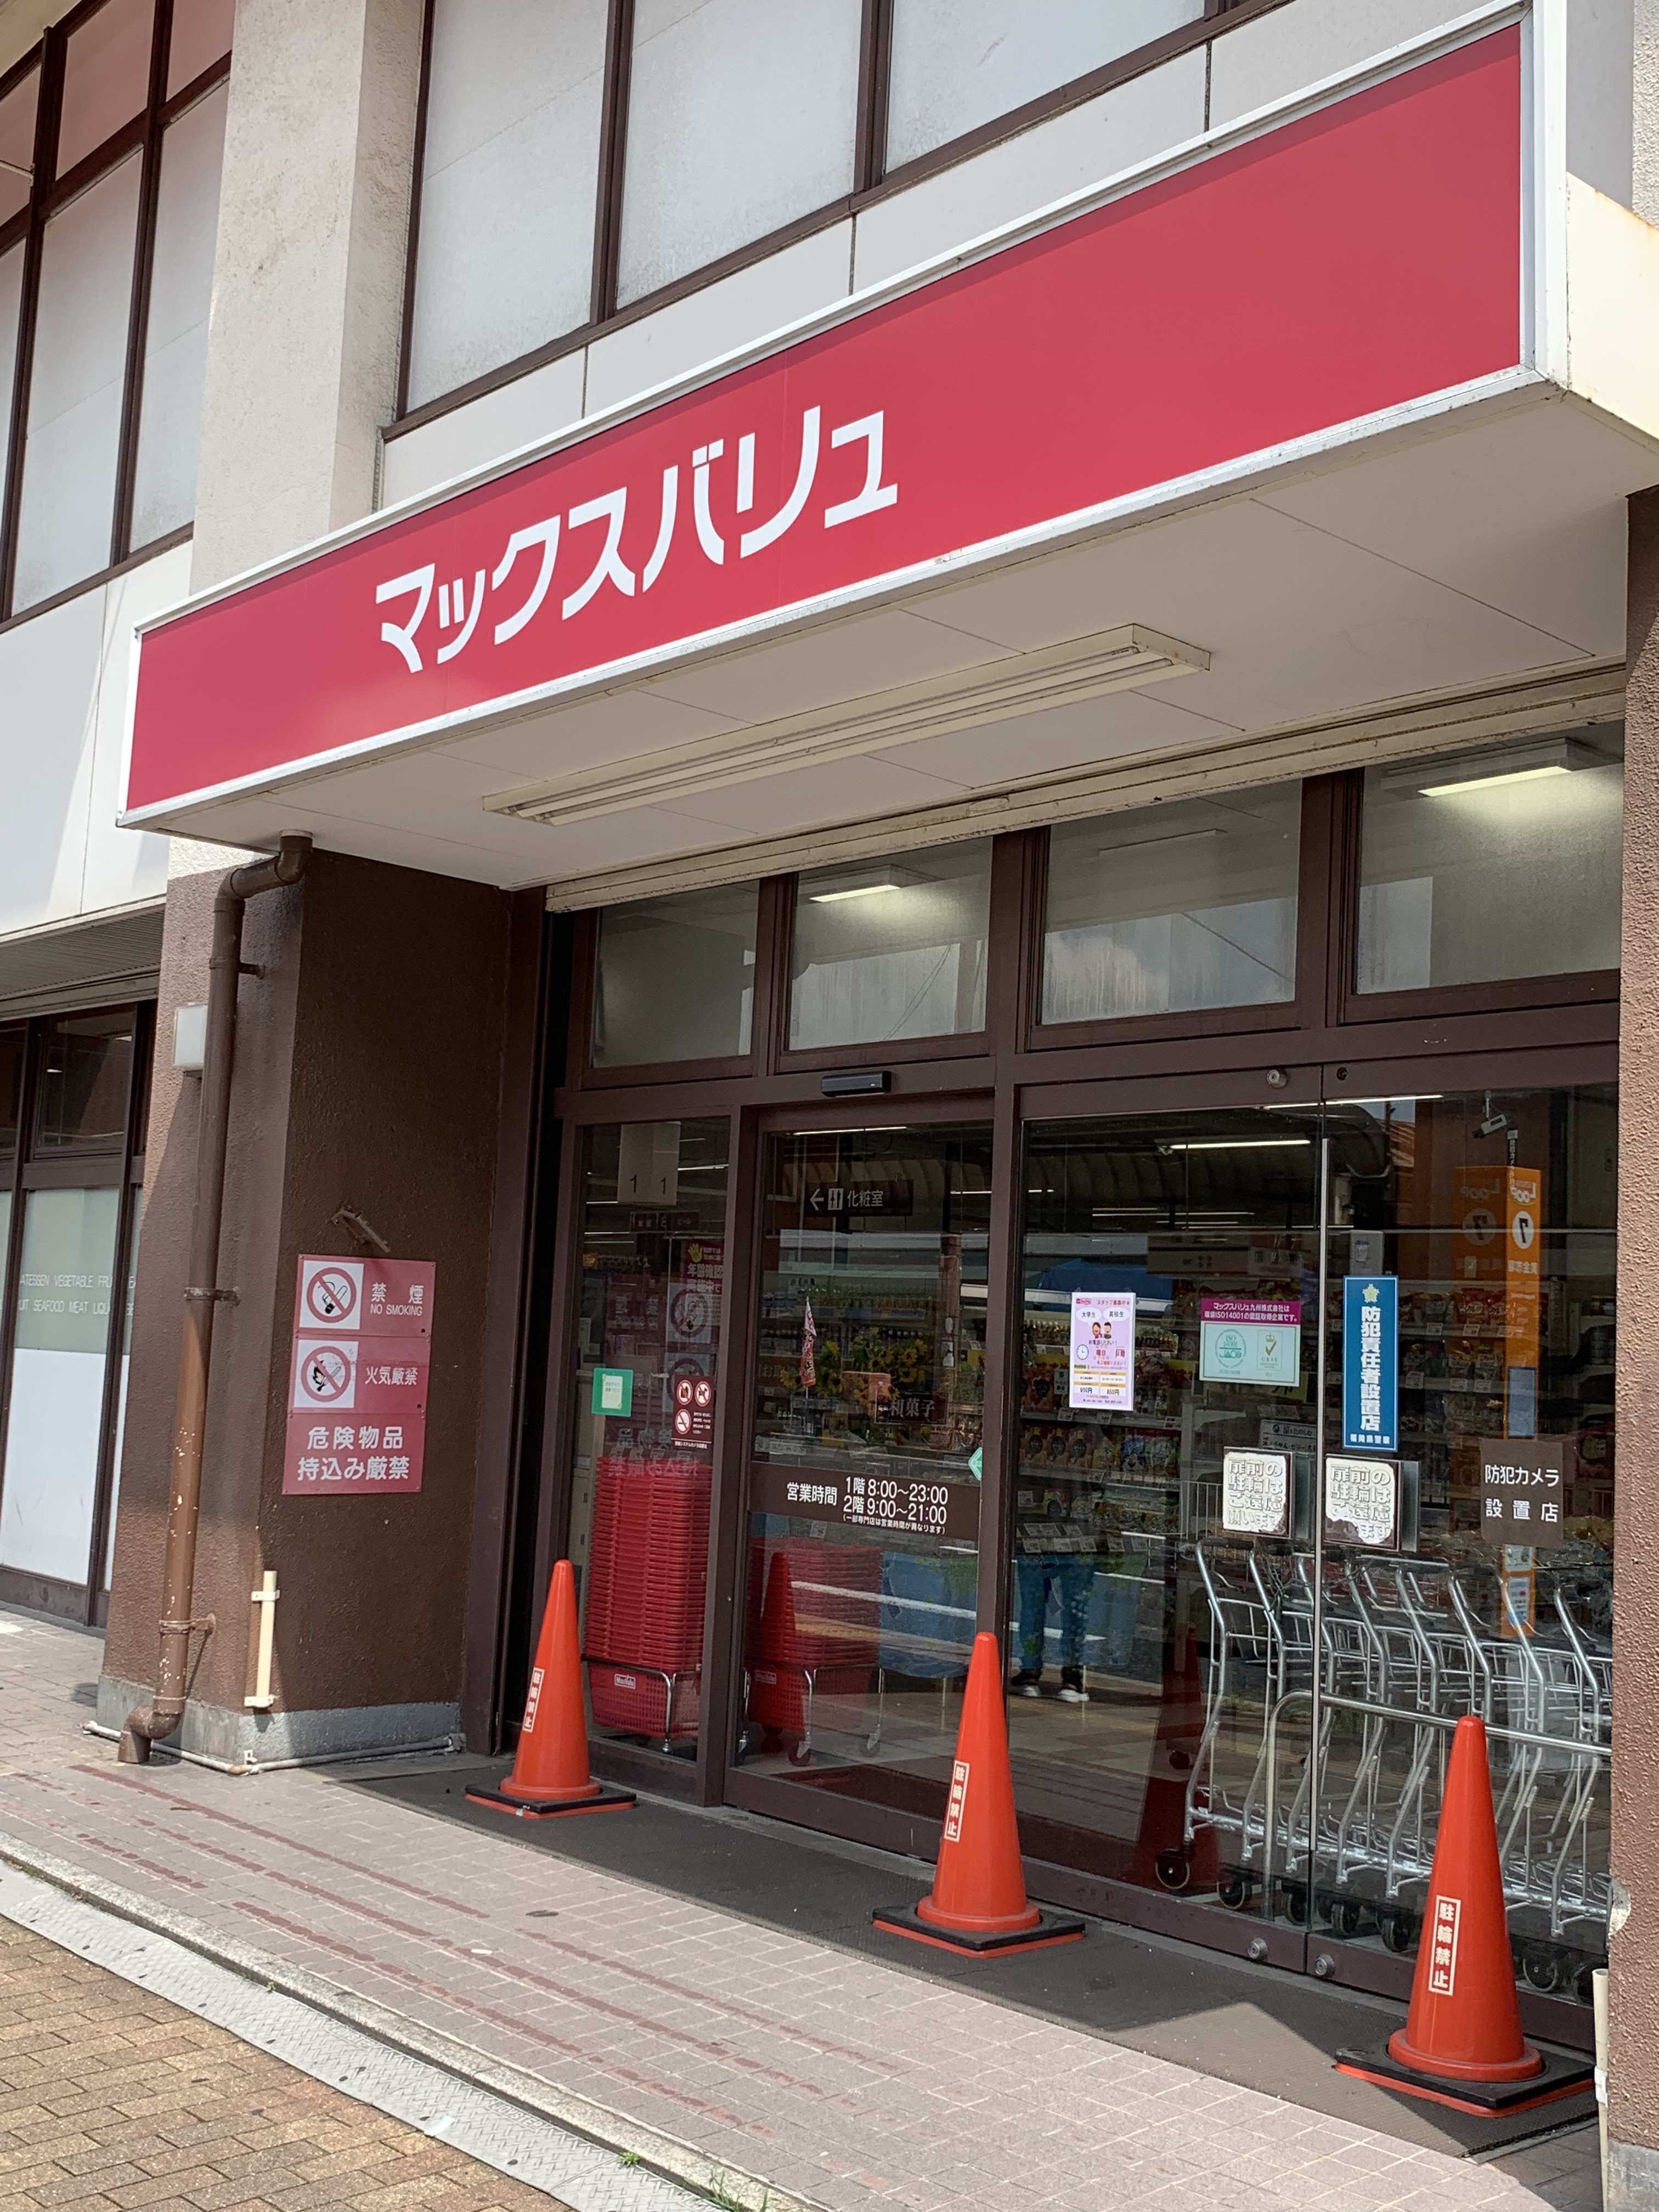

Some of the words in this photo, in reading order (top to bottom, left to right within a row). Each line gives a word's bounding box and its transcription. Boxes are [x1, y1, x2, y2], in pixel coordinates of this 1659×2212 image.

[375, 404, 898, 674] マックスバリュ
[847, 1189, 884, 1208] 化粧室
[54, 1275, 93, 1288] VEGETABLE
[98, 1276, 113, 1288] FRU
[33, 1299, 65, 1313] SEAFOOD
[69, 1301, 89, 1314] MEAT
[93, 1302, 110, 1316] LIQU
[370, 1304, 383, 1316] NO
[386, 1304, 423, 1317] SMOKING
[1213, 1302, 1290, 1313] マックスバリュ九州株式会社は
[365, 1366, 417, 1386] 火気厳禁
[1360, 1305, 1381, 1432] 防犯責任者設置店
[890, 1397, 936, 1419] 和菓子
[307, 1425, 403, 1451] 危険物品
[297, 1456, 410, 1481] 持込み厳禁
[1228, 1458, 1283, 1477] 扉前の
[1330, 1465, 1391, 1486] 扉前の
[1485, 1464, 1560, 1487] 防犯カメラ
[787, 1482, 838, 1506] 営業時間
[845, 1476, 865, 1495] 1階
[1228, 1475, 1283, 1495] 駐輪は
[1330, 1482, 1391, 1504] 駐輪は
[843, 1495, 865, 1514] 2階
[1228, 1491, 1283, 1513] ご遠慮
[1358, 1521, 1390, 1541] ます
[947, 1766, 966, 1836] 駐輪禁止
[1433, 1902, 1455, 1989] 駐輪禁止
